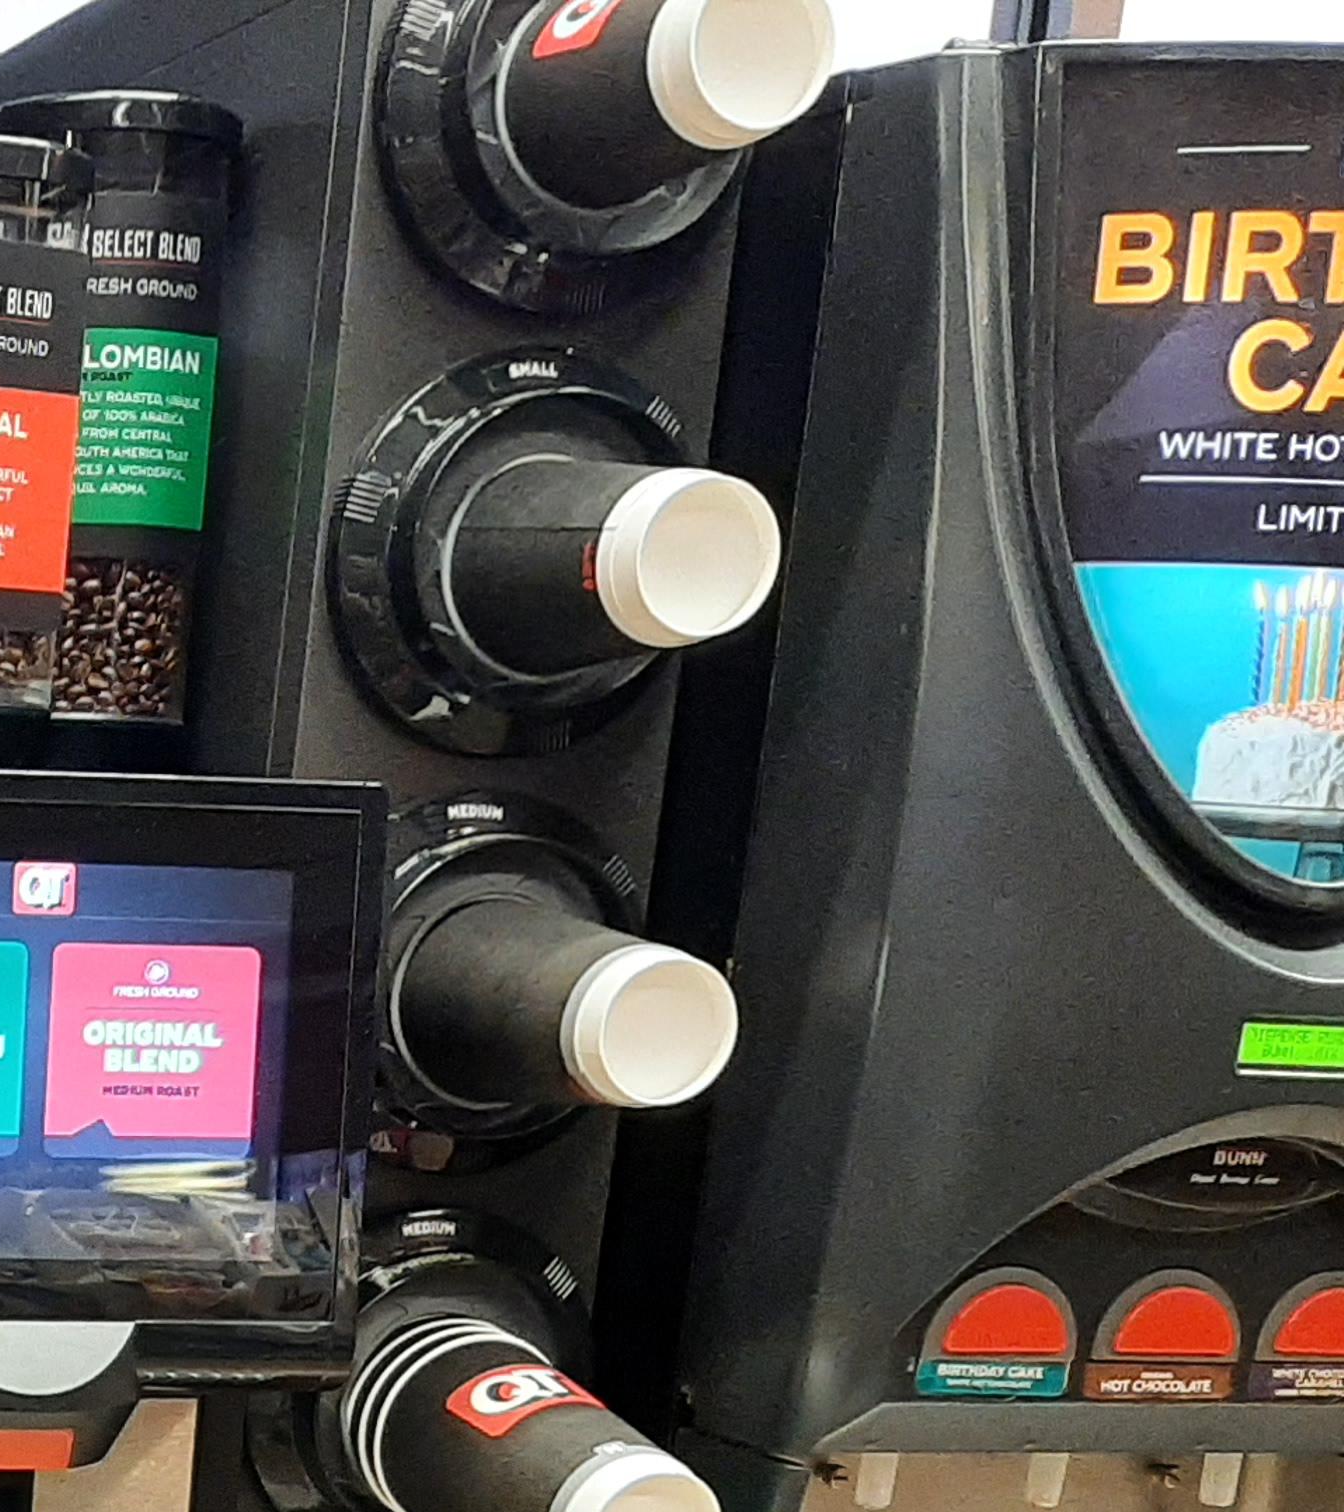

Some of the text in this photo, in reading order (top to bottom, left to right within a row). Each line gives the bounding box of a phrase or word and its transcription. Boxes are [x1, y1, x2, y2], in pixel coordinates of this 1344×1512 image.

[92, 229, 154, 258] SELECT
[159, 232, 201, 264] BLEND
[86, 278, 198, 300] RESH GROUND
[6, 287, 52, 320] BLEND
[83, 344, 200, 374] LOMBIAN
[509, 361, 558, 379] SMALL
[1159, 430, 1344, 463] WHITE HO
[447, 804, 504, 821] MEDIUM
[19, 868, 68, 909] QT
[151, 987, 199, 1000] GROUND
[83, 1021, 223, 1048] ORIGINAL
[104, 1048, 201, 1074] BLEND
[103, 1085, 199, 1098] MEDIUM ROAST
[402, 1220, 456, 1237] MEDIUM
[1100, 1379, 1212, 1394] HOT CHOCOLATE
